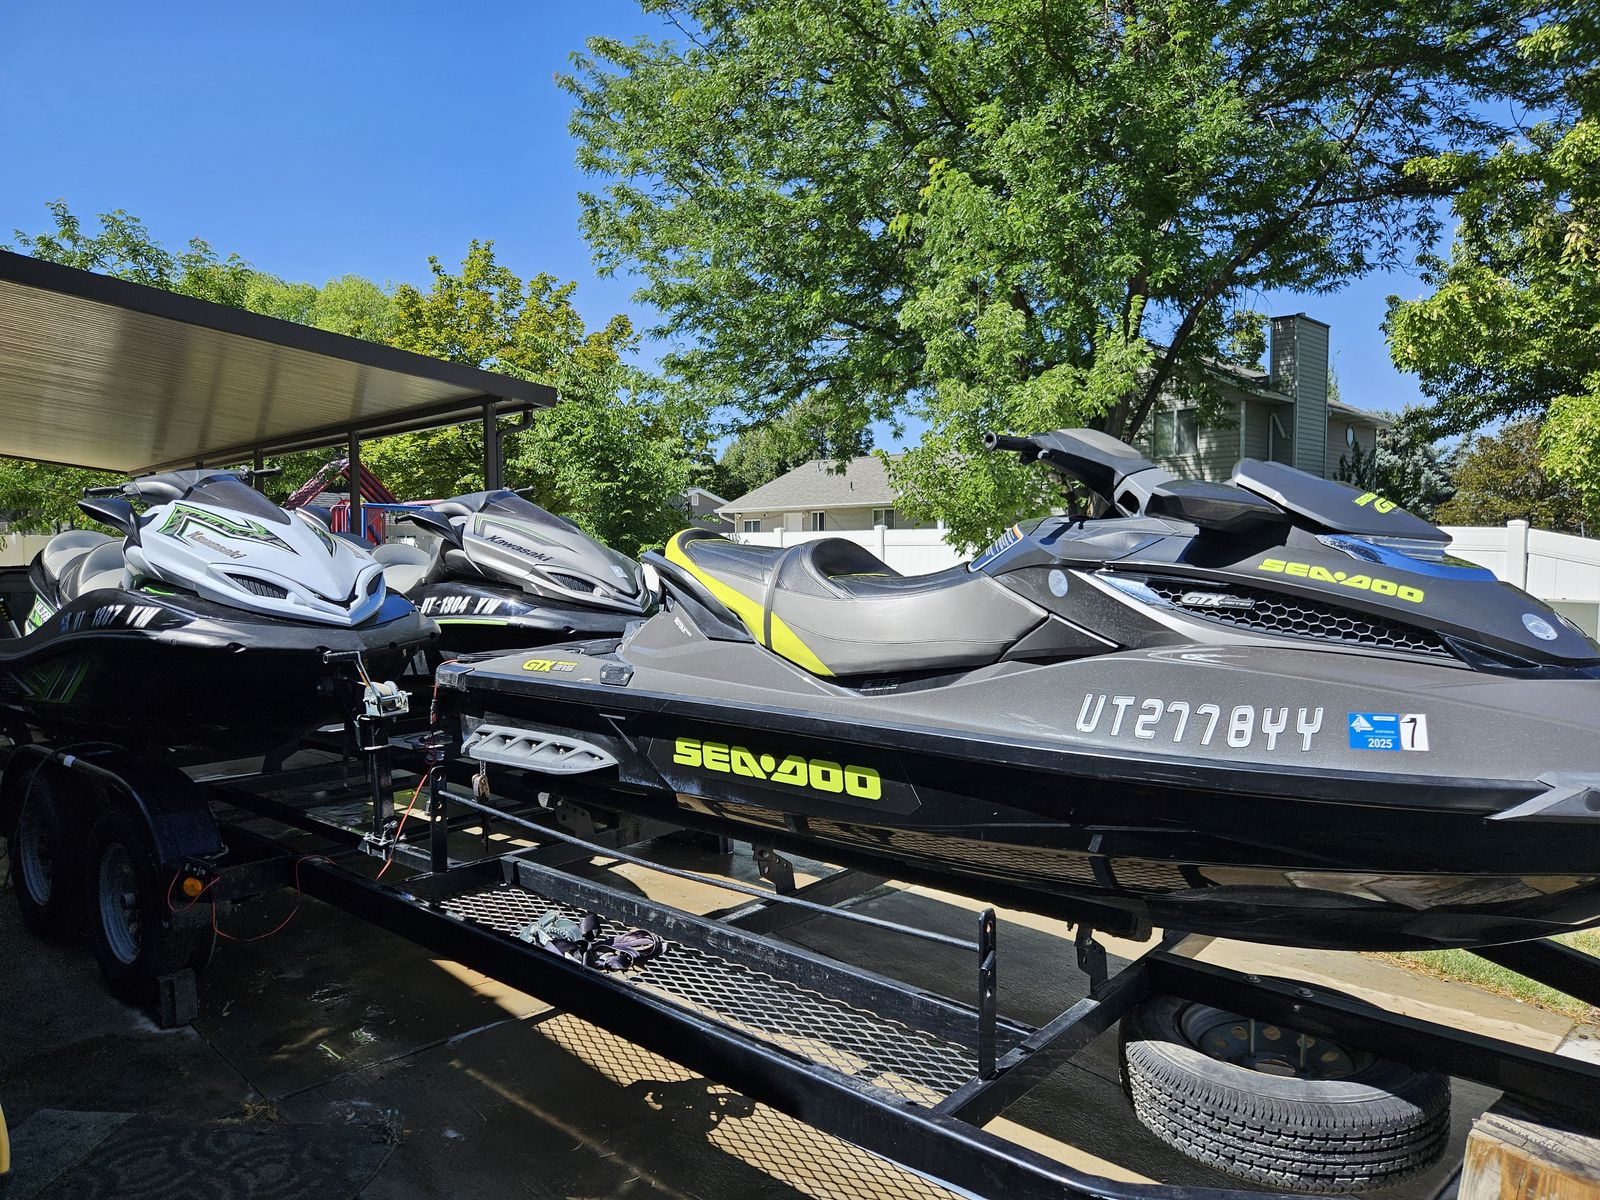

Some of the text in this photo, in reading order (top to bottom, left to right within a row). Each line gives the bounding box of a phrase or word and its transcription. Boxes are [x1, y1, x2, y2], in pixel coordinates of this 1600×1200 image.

[485, 534, 553, 561] Kawasaki
[1181, 592, 1228, 607] GTX
[522, 659, 558, 673] GTX
[1367, 738, 1393, 749] 2025
